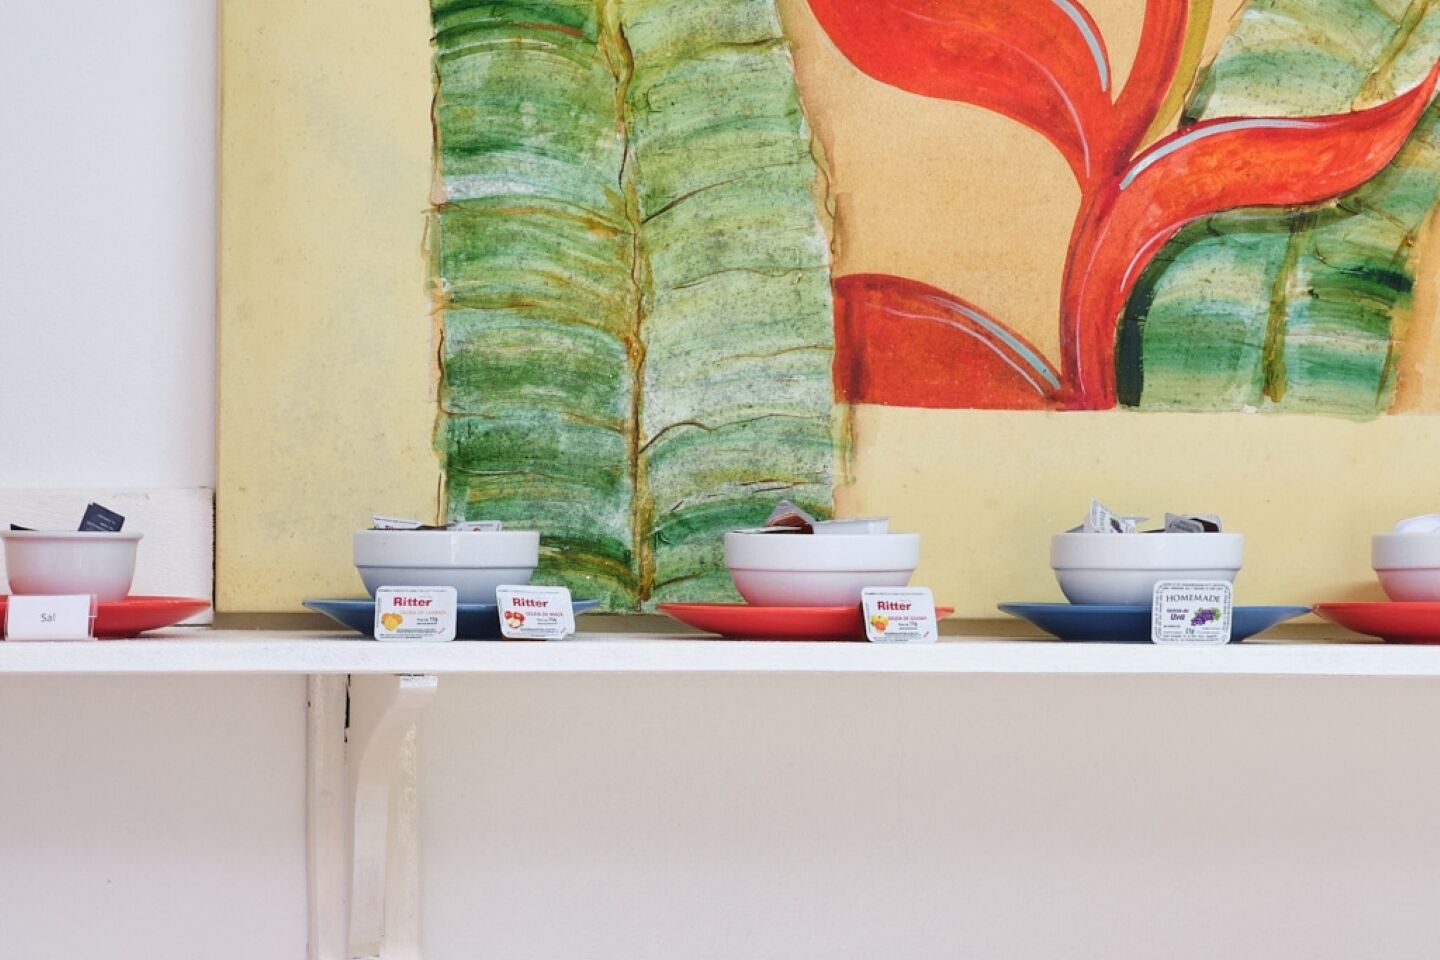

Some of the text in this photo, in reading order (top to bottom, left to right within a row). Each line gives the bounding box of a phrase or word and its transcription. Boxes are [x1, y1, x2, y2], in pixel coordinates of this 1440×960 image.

[393, 597, 433, 607] Ritter
[512, 597, 548, 608] Ritter
[1166, 594, 1220, 603] HOMEMADE
[877, 600, 912, 611] Ritter
[40, 613, 55, 622] Sal
